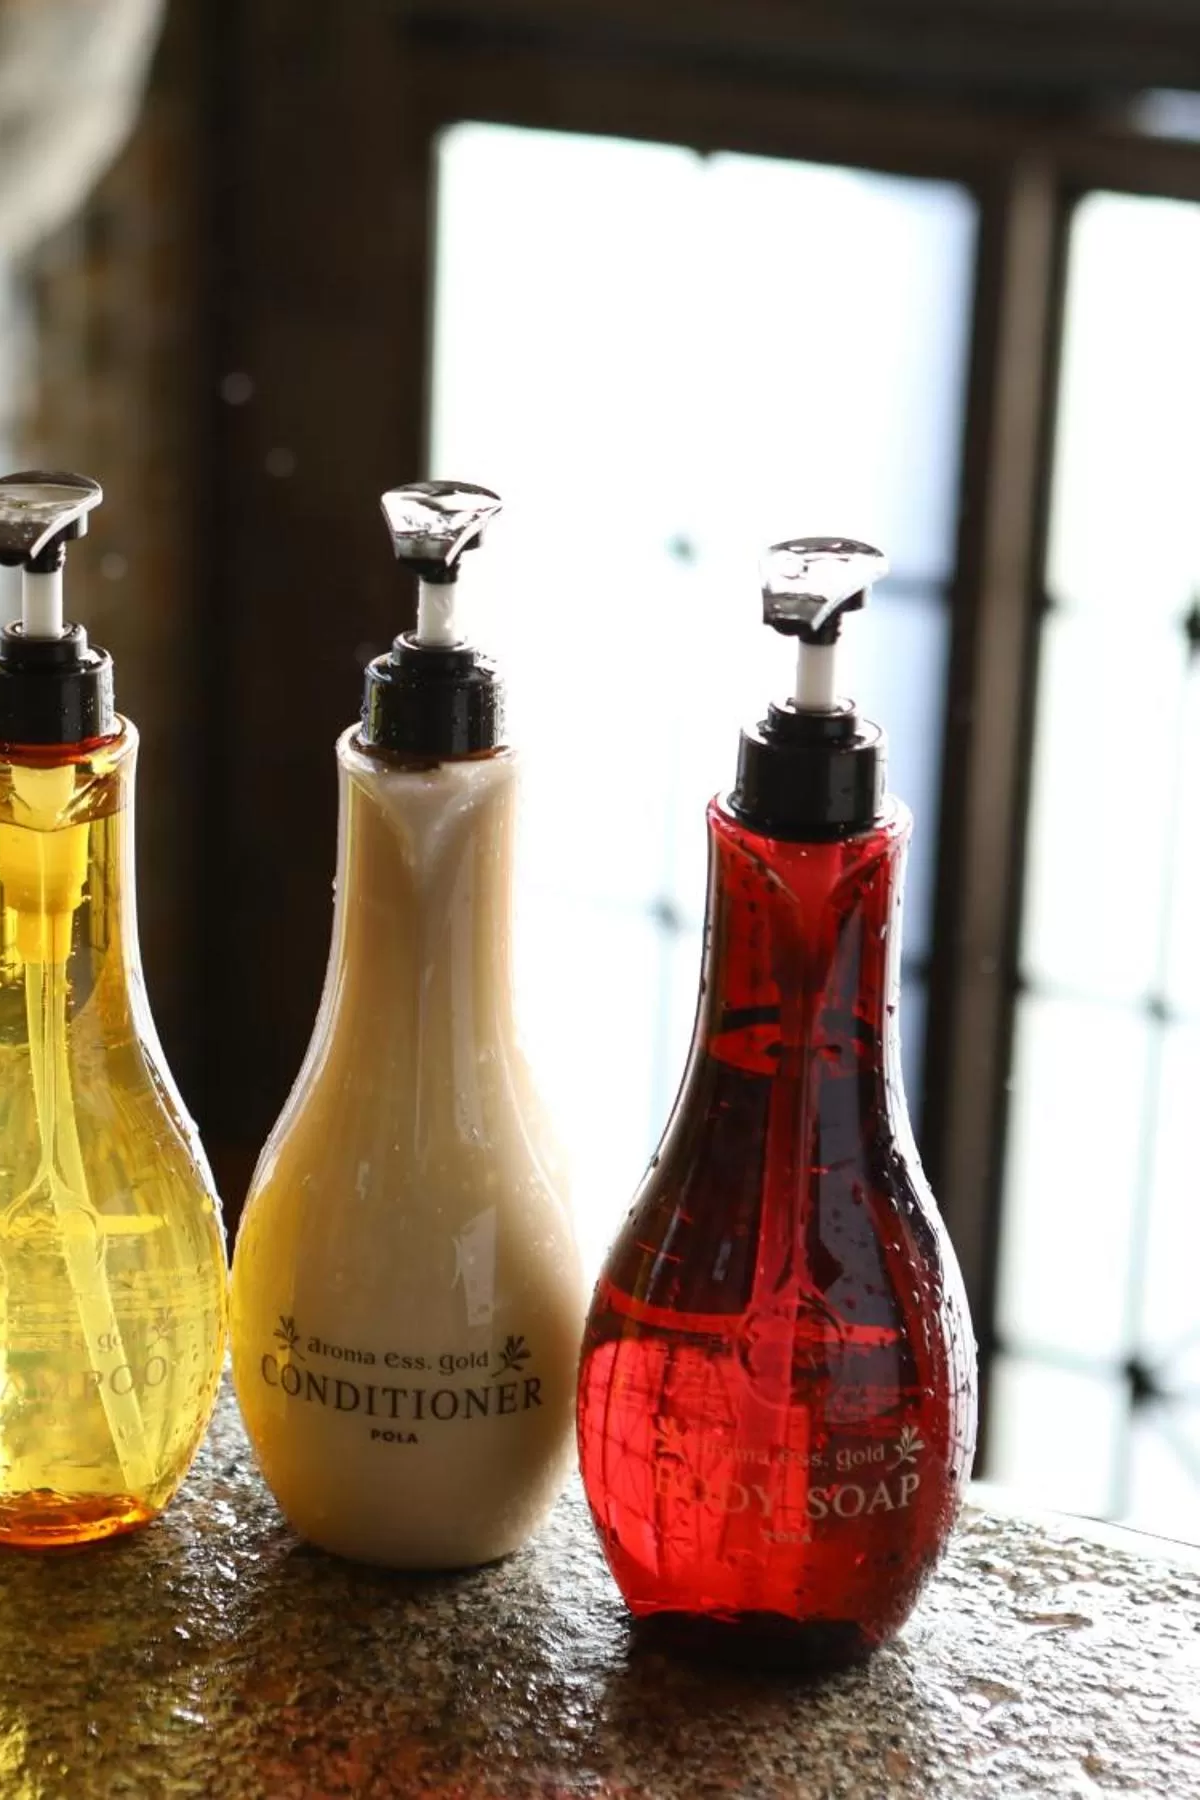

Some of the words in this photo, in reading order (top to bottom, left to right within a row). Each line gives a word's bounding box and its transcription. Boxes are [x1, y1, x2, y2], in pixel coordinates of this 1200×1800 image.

[307, 1336, 376, 1366] aroma
[384, 1351, 432, 1371] ess.
[439, 1350, 490, 1376] gold
[261, 1353, 543, 1421] CONDITIONER
[371, 1428, 419, 1445] POLA
[836, 1443, 885, 1471] gold
[805, 1473, 920, 1519] SOAP
